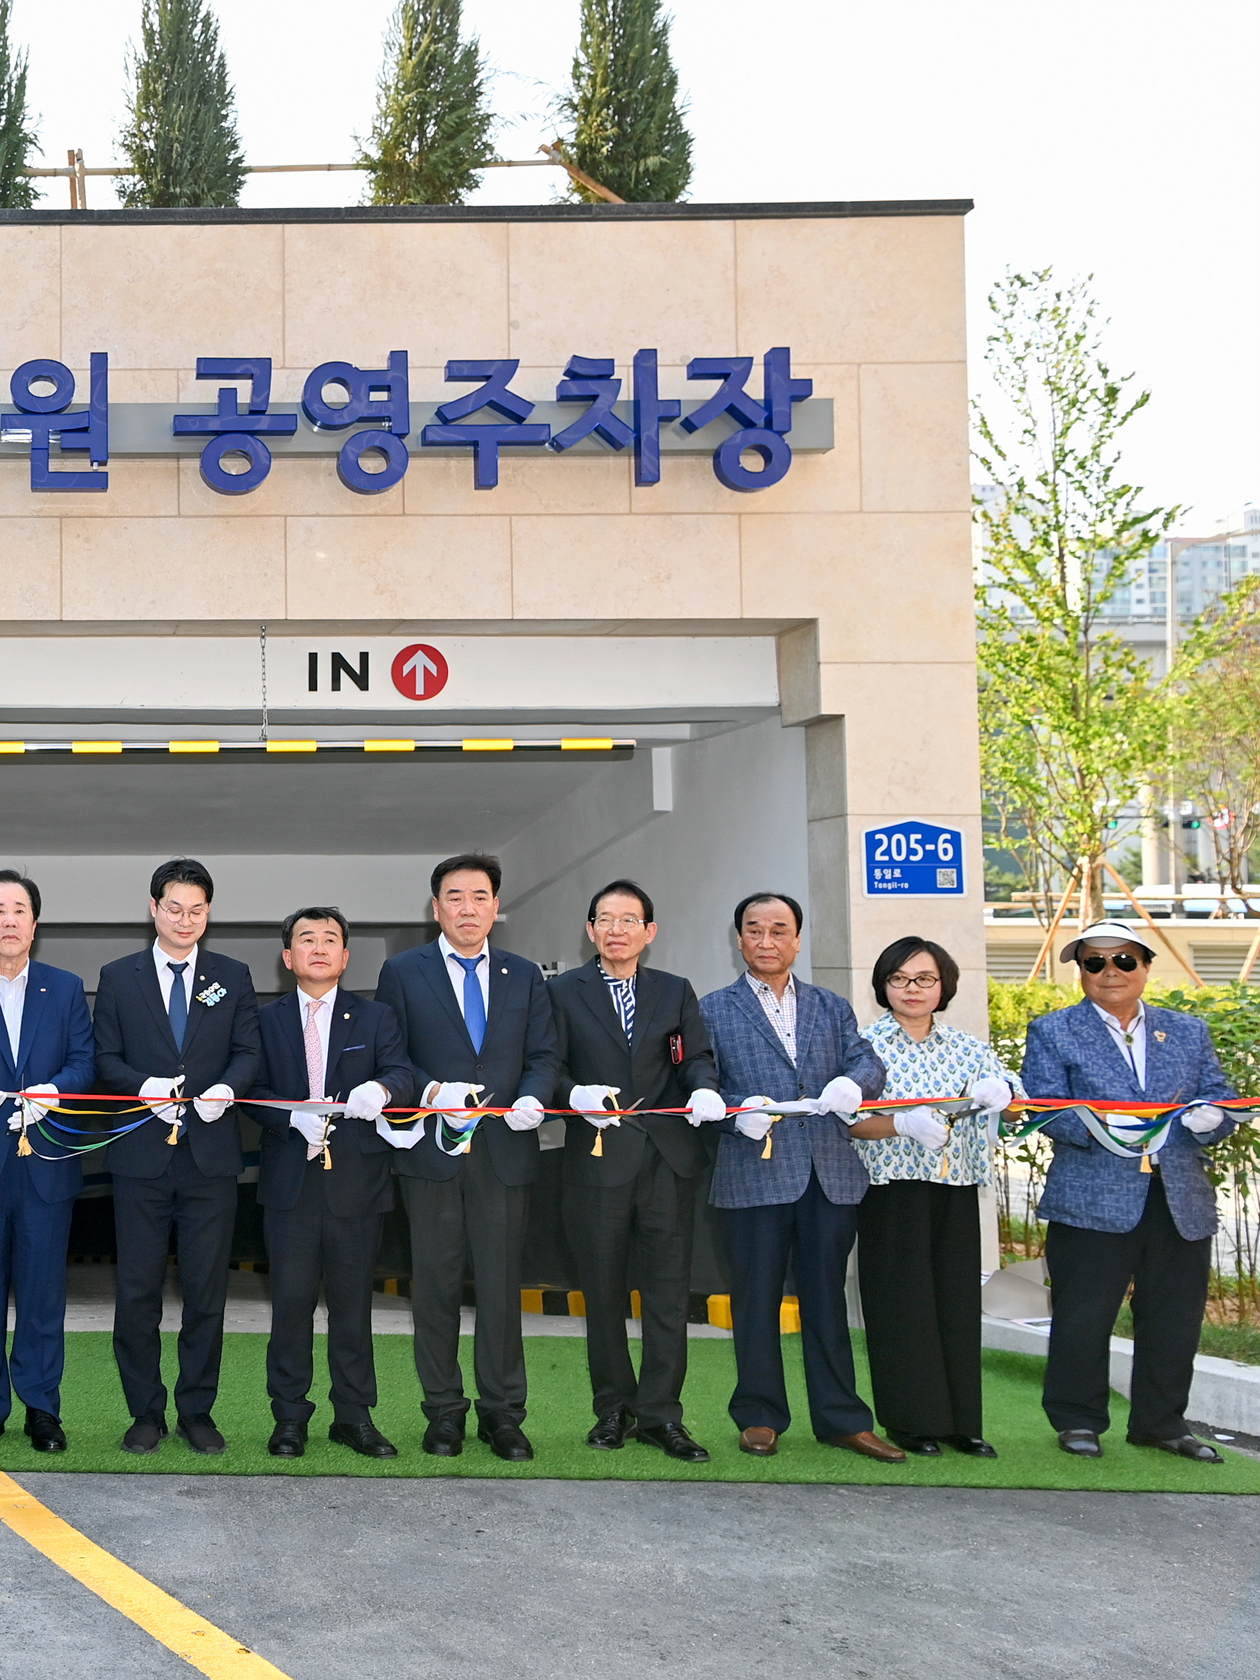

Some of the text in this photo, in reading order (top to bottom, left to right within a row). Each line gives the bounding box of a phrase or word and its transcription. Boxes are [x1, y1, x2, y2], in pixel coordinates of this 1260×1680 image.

[173, 347, 813, 496] 공영주차장
[308, 651, 369, 692] IN
[874, 833, 954, 862] 205-6
[873, 868, 902, 880] 통일로
[873, 881, 909, 891] Tongil-ro
